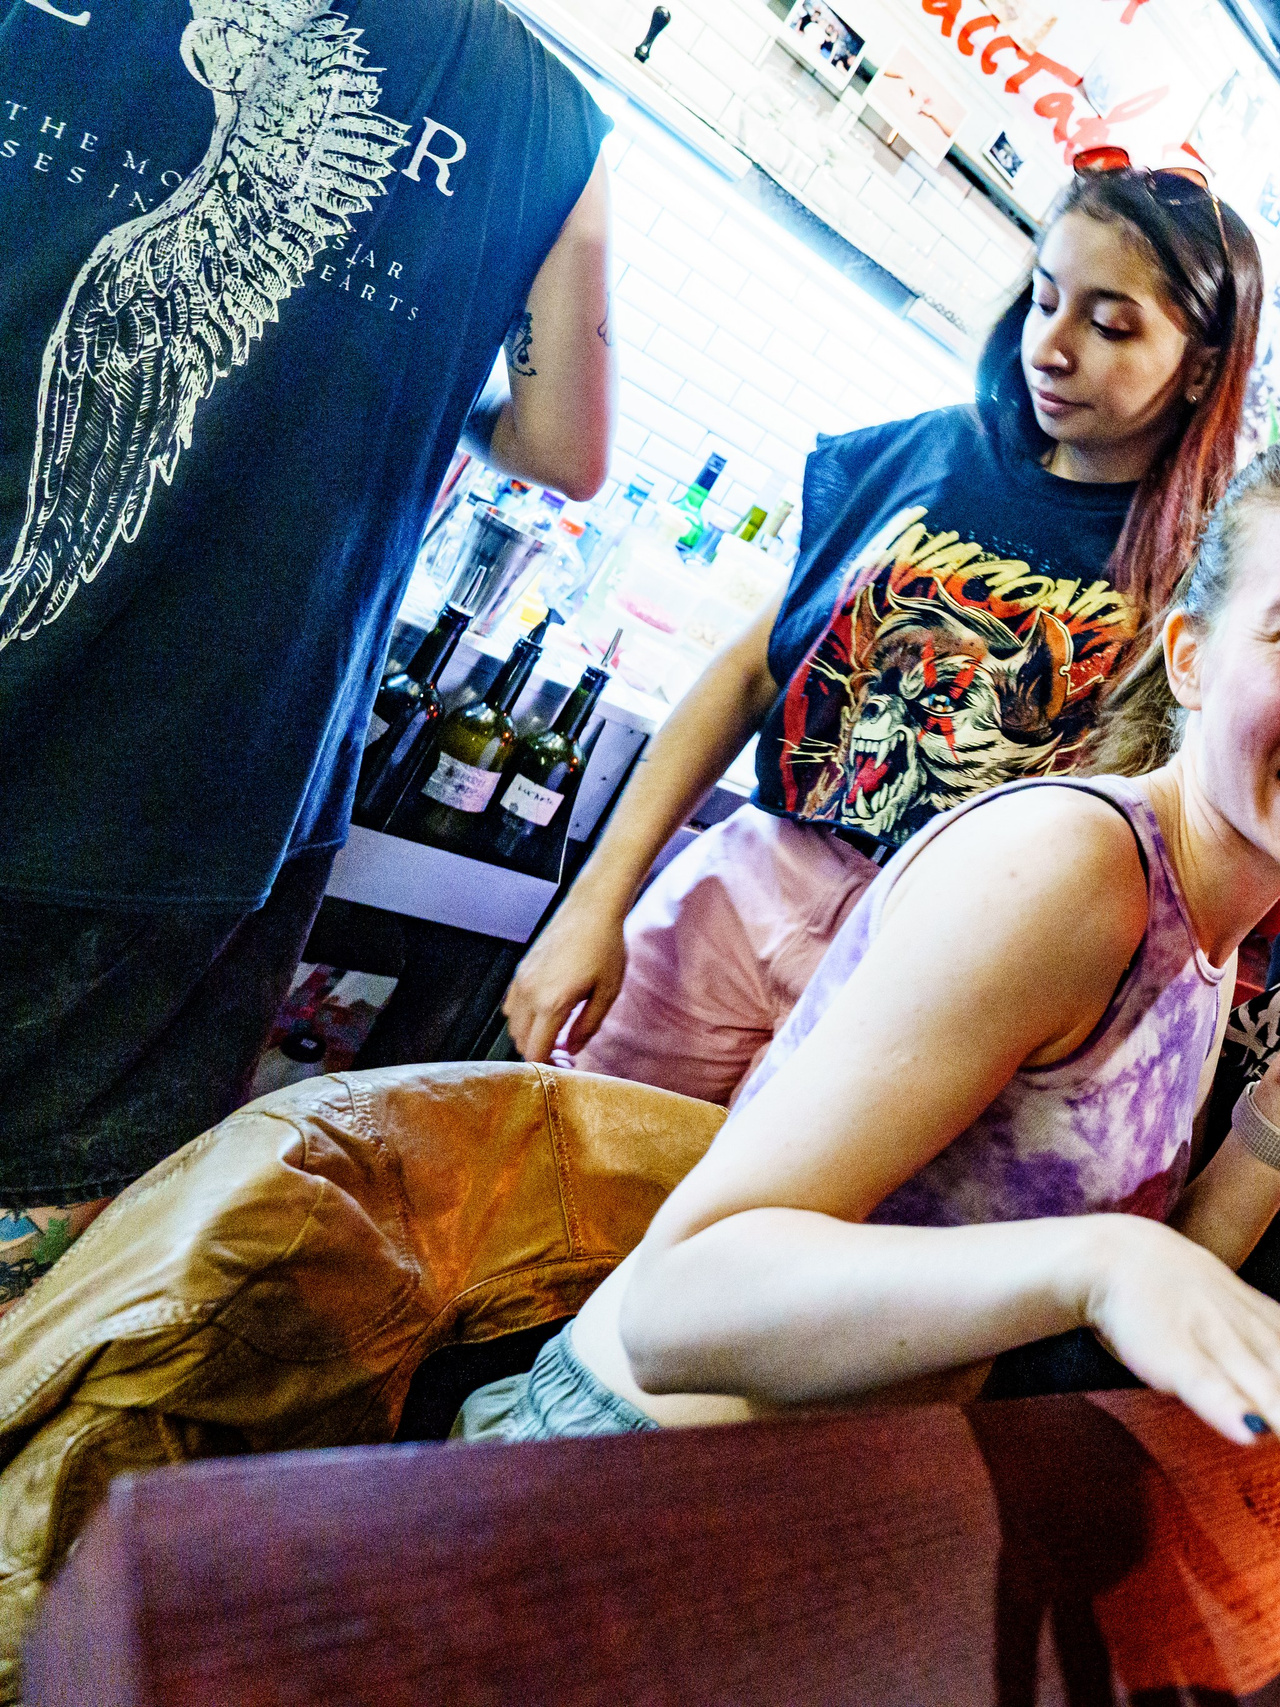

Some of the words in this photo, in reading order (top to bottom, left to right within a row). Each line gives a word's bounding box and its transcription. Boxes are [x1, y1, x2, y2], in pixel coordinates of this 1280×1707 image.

[5, 100, 98, 152] THE
[123, 150, 183, 188] MO
[319, 263, 419, 321] EARTS
